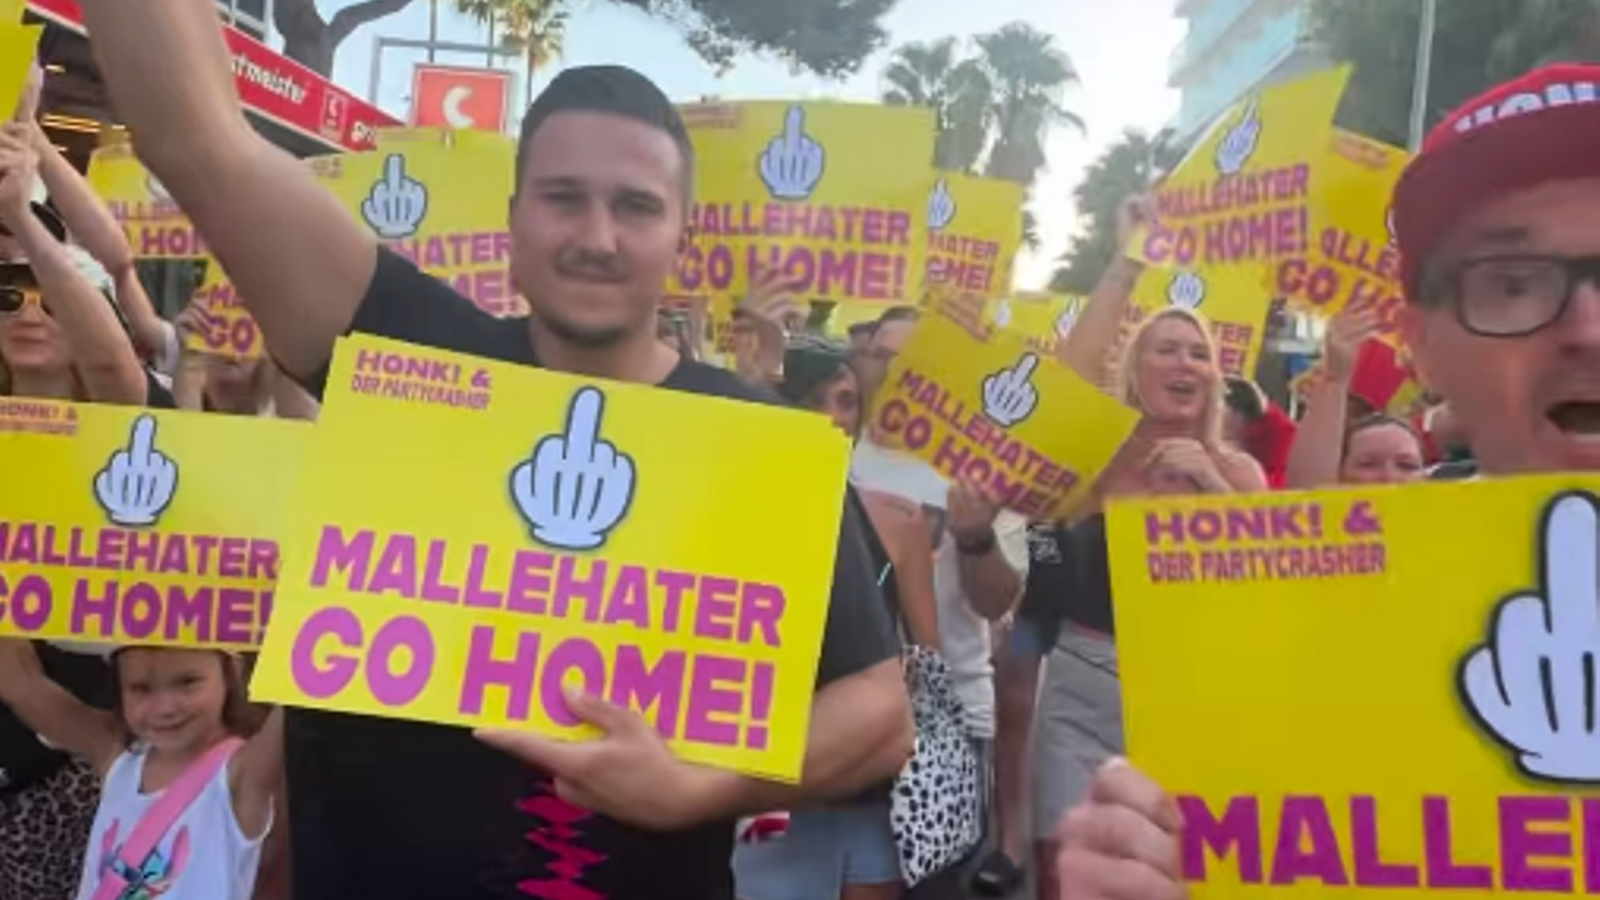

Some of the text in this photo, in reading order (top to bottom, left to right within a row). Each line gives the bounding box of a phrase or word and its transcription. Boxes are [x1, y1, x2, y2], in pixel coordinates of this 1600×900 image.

[1143, 205, 1308, 264] GO HOME!
[680, 244, 733, 291] GO
[1278, 257, 1339, 306] GO
[206, 315, 255, 353] GO
[356, 349, 493, 388] HONK! &
[879, 396, 933, 450] GO
[902, 367, 1079, 490] MALLEHATER
[1144, 500, 1384, 545] HONK! &
[309, 524, 787, 649] MALLEHATER
[1147, 542, 1386, 584] DER PARTYCRASHER
[70, 577, 274, 646] HOME!
[290, 605, 775, 751] GO HOME!
[1175, 794, 1600, 895] MALLE
